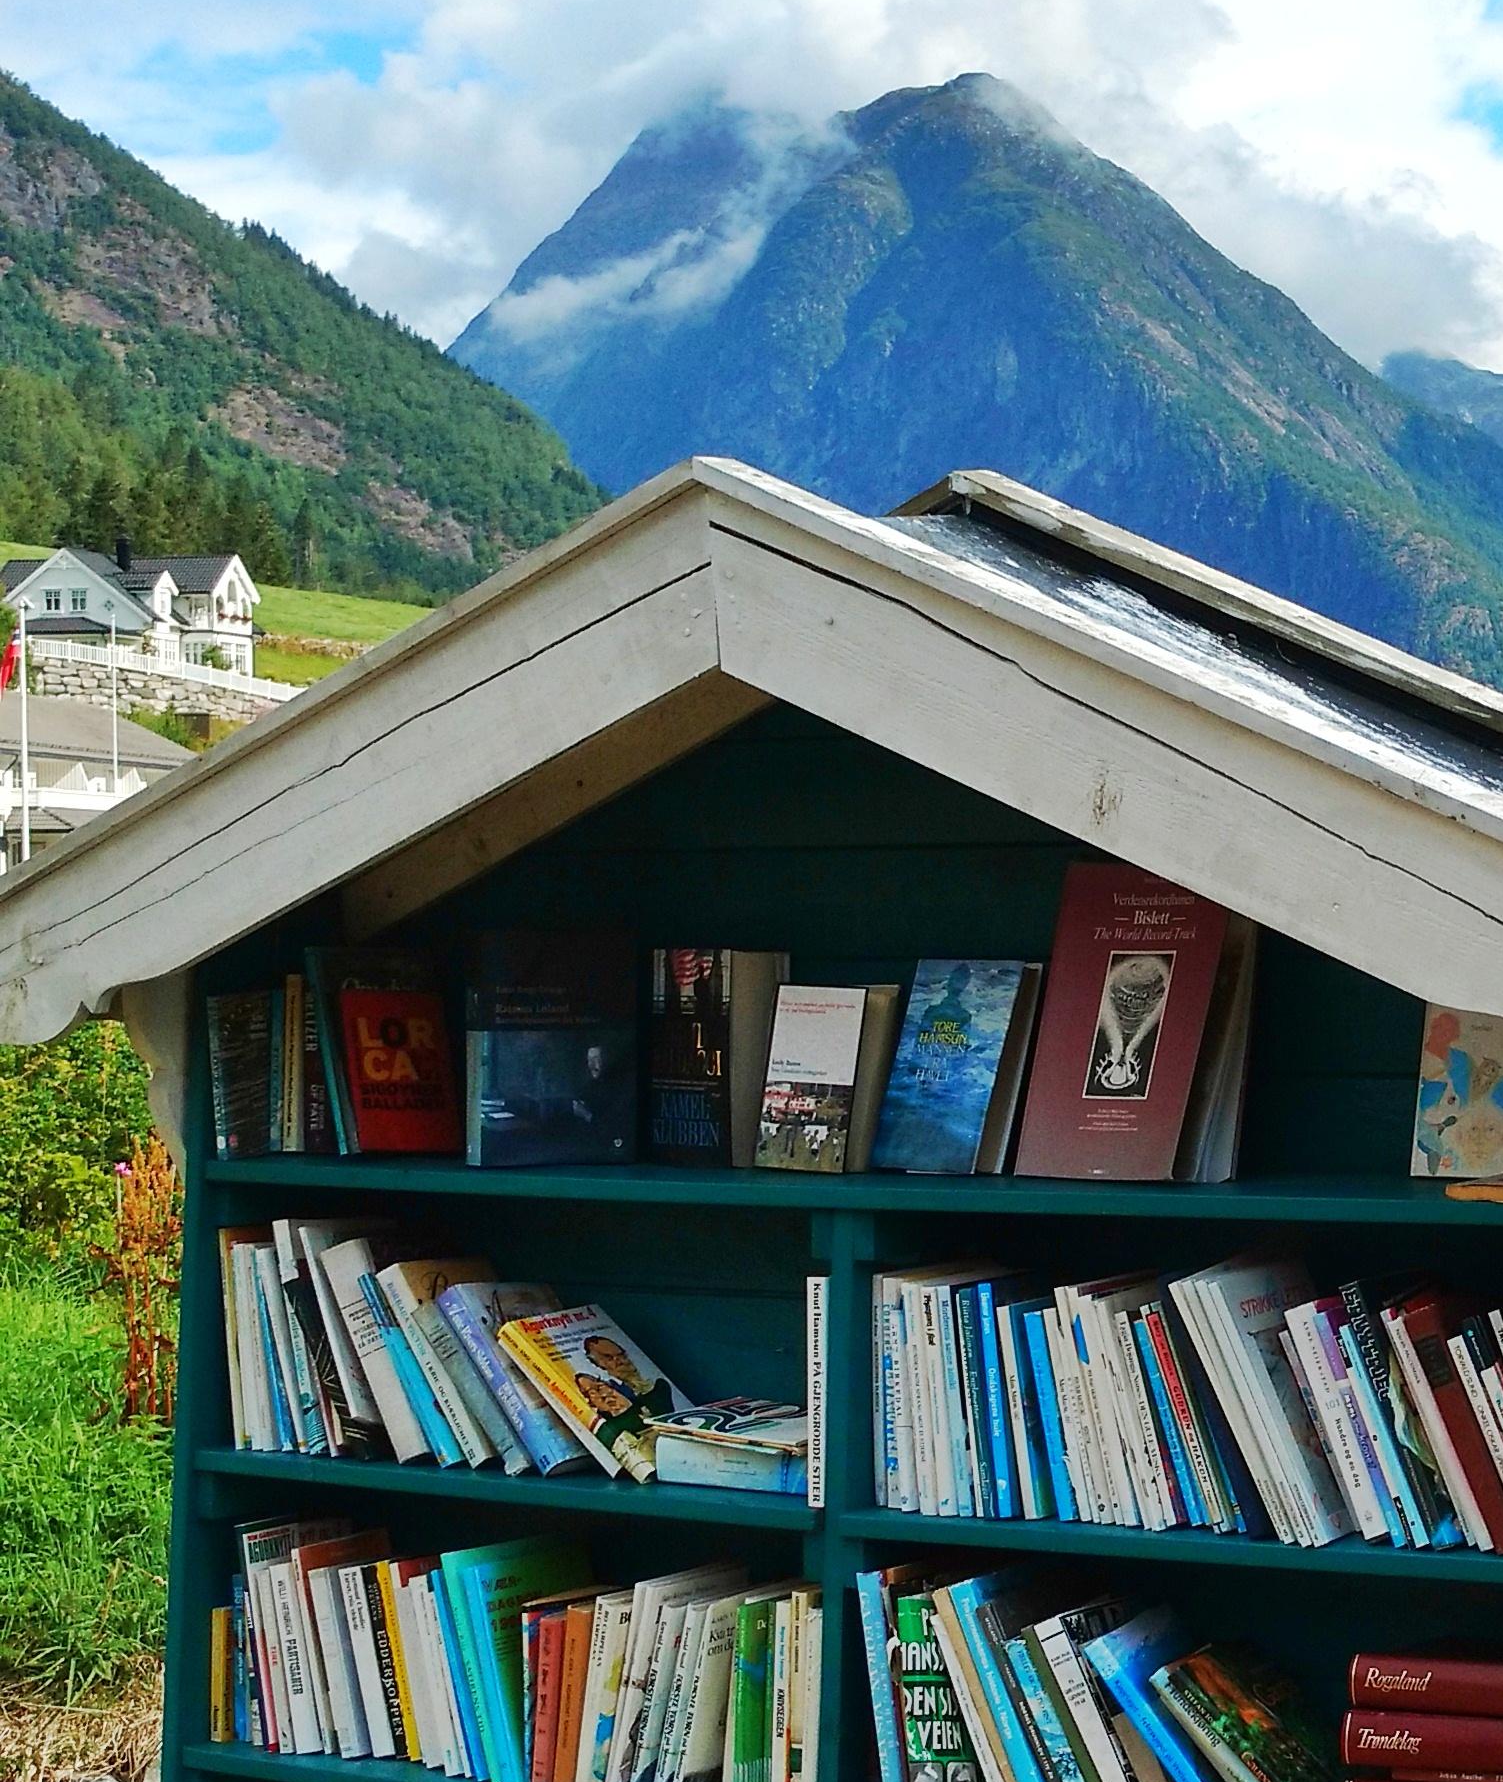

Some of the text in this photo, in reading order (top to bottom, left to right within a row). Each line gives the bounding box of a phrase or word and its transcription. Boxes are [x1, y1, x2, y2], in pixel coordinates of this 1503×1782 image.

[1134, 910, 1170, 925] Bislett
[1094, 927, 1112, 939] The
[919, 1032, 968, 1044] HAMSUN
[933, 1021, 961, 1033] TORE
[361, 1050, 418, 1081] CA
[652, 1122, 720, 1147] KLUBBEN
[813, 1361, 823, 1376] PÅ
[986, 1366, 1000, 1416] Ondskapens
[812, 1380, 820, 1462] GJENGRODDE
[1172, 1384, 1192, 1430] GUDRUN
[1333, 1417, 1349, 1447] Hundre
[1343, 1449, 1352, 1460] og
[1350, 1472, 1362, 1488] dag
[812, 1465, 820, 1502] STIER
[350, 1571, 360, 1599] Raymond
[707, 1644, 724, 1657] om
[372, 1629, 404, 1736] EDDERKOPPEN
[1364, 1667, 1432, 1694] Rogaland
[775, 1688, 786, 1738] KNIVSEGGEN
[1164, 1679, 1221, 1748] Hundekjøring
[1182, 1688, 1206, 1714] STEFAN
[917, 1721, 963, 1750] VEIEN
[1357, 1728, 1422, 1754] Trøndelag
